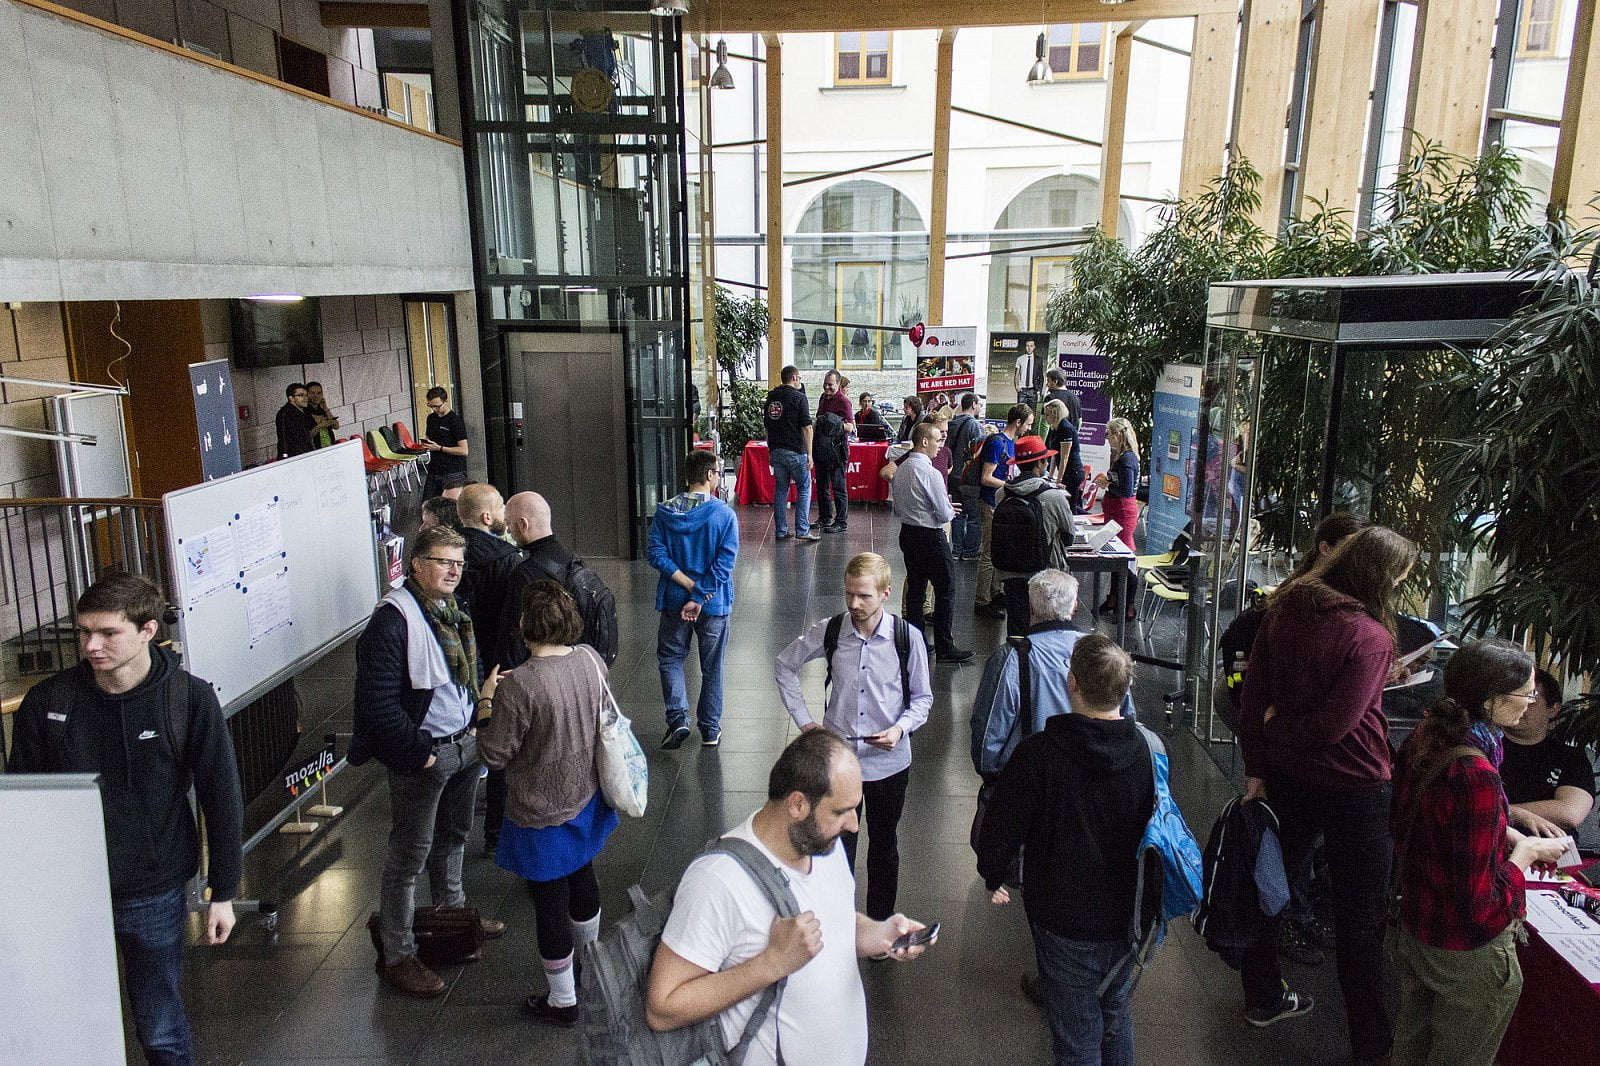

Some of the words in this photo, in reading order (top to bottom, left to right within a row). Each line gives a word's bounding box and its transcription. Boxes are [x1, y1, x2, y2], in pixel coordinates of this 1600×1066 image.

[1061, 360, 1078, 369] Gain
[1078, 362, 1083, 370] 3
[1066, 370, 1109, 380] ualifications
[931, 380, 944, 388] ARE
[944, 379, 957, 387] RED
[958, 378, 971, 386] HAT
[848, 462, 861, 473] AT
